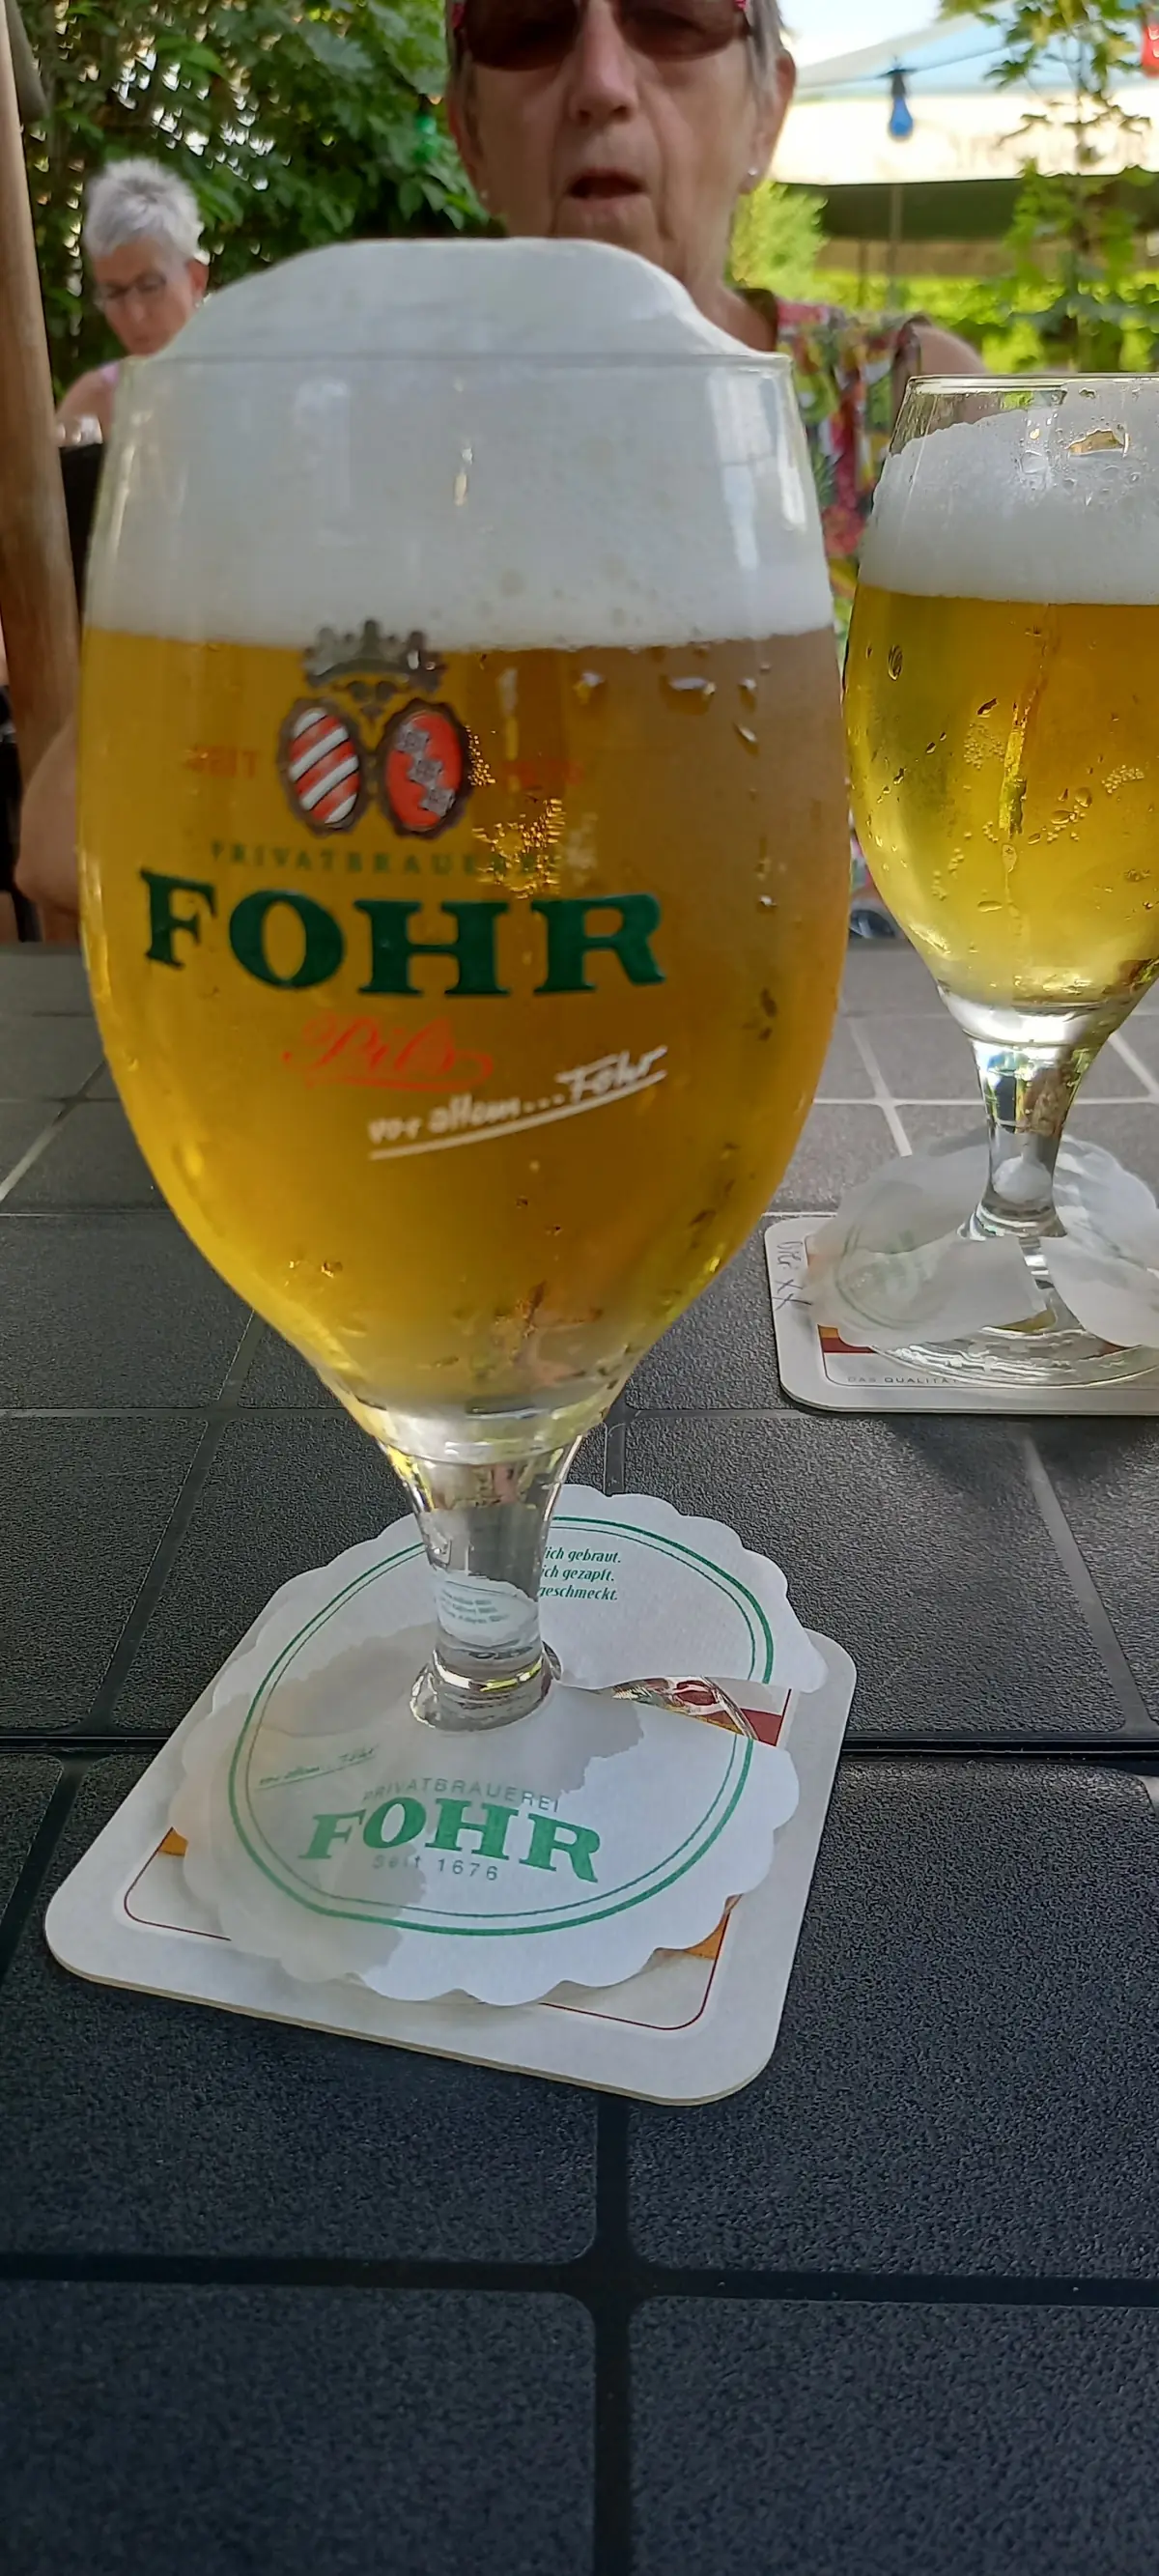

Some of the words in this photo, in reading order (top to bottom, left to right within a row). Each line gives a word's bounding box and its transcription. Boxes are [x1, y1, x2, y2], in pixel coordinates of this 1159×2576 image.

[139, 867, 666, 999] FOHR
[280, 1012, 495, 1092] Pils
[568, 1548, 621, 1564] gebraut.
[363, 1777, 559, 1813] PRIVATBRAUEREI
[297, 1797, 601, 1883] FOHR
[372, 1854, 422, 1870] Seit
[438, 1858, 499, 1881] 1676
